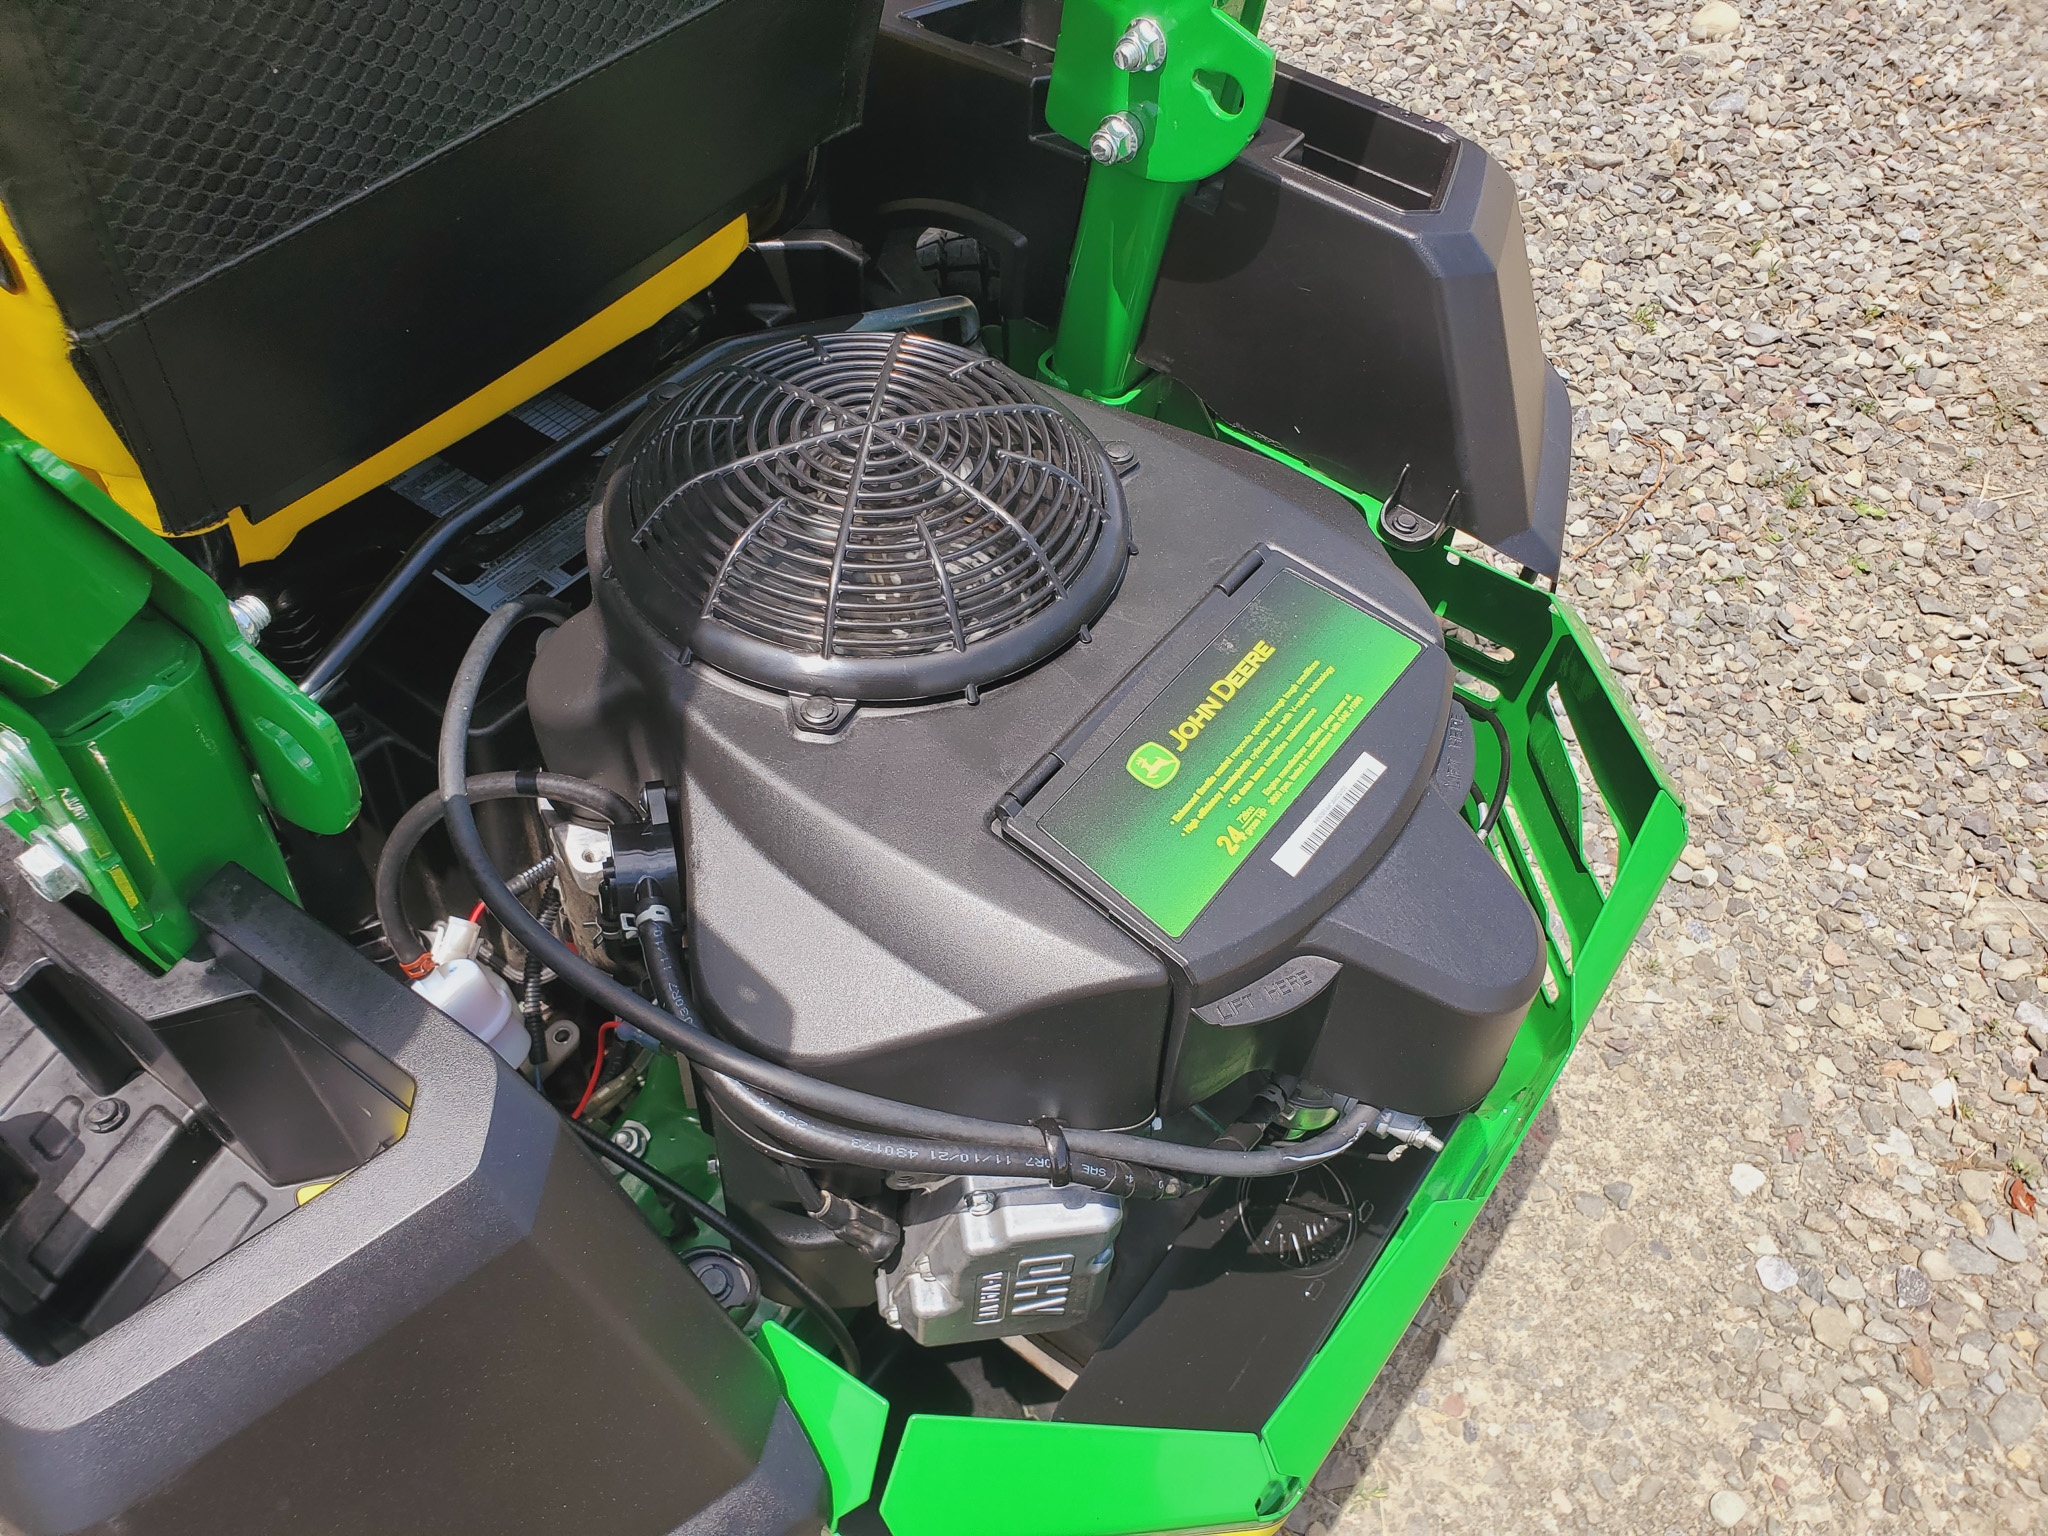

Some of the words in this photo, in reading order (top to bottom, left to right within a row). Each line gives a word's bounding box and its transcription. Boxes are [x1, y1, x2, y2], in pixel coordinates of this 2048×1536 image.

[1168, 695, 1224, 752] JOHN
[1209, 639, 1276, 702] DEERE
[1330, 722, 1341, 733] with
[1338, 710, 1351, 723] SAE
[1172, 793, 1200, 822] Enhanced
[1196, 775, 1216, 795] throttle
[1214, 756, 1233, 776] control
[1230, 735, 1253, 759] responds
[1251, 717, 1270, 735] quickly
[1266, 698, 1286, 717] through
[1283, 684, 1299, 699] tough
[1296, 660, 1320, 685] conditions
[1183, 818, 1200, 833] High
[1197, 791, 1224, 819] efficiency
[1250, 737, 1270, 760] cylinder
[1267, 723, 1283, 738] head
[1280, 713, 1293, 724] with
[1307, 665, 1335, 693] technology
[1230, 794, 1241, 804] Oil
[1238, 780, 1254, 795] drain
[1286, 708, 1317, 741] maintenance
[1262, 777, 1281, 796] Engine
[1321, 714, 1335, 729] gross
[1332, 699, 1347, 716] power
[1216, 825, 1247, 856] 24
[1245, 818, 1261, 836] gross
[1256, 808, 1267, 819] HP
[1216, 993, 1255, 1021] LIFT
[1264, 969, 1313, 1001] HERE
[930, 1150, 1012, 1166] 11/10/21
[1081, 1163, 1107, 1177] SAE
[1010, 1253, 1076, 1316] OHV
